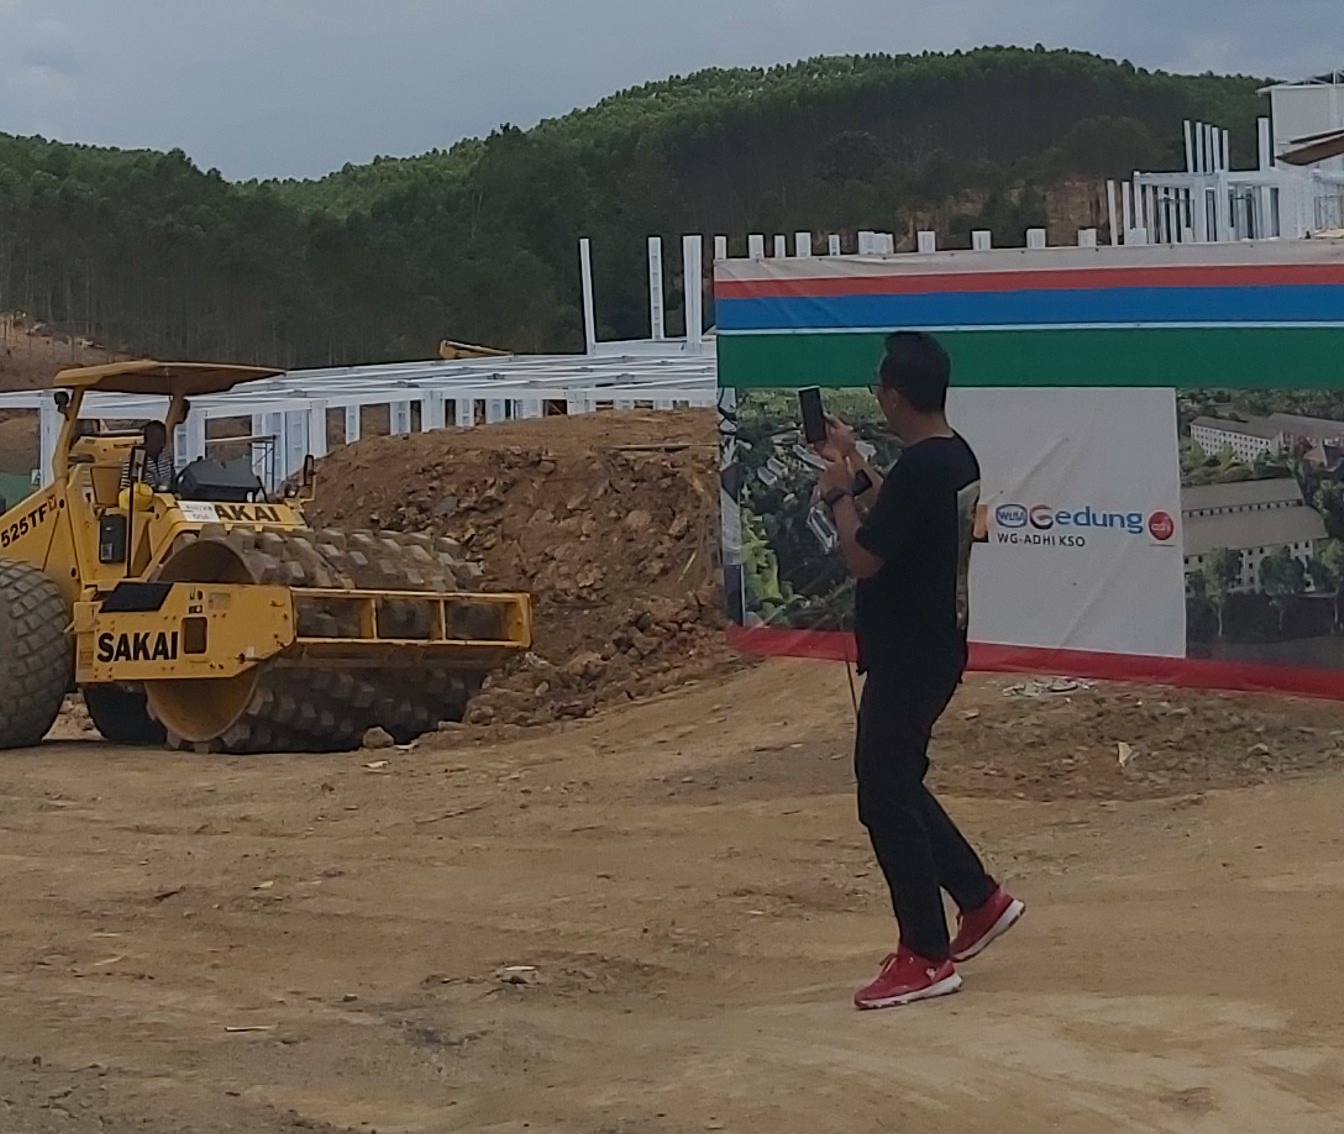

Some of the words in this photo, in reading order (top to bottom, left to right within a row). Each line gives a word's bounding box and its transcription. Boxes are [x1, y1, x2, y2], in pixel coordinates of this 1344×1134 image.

[213, 503, 281, 523] AKAI
[1029, 504, 1144, 535] Gedung
[997, 532, 1056, 545] WG-ADHI
[1058, 535, 1086, 548] KSO
[97, 630, 179, 661] SAKAI
